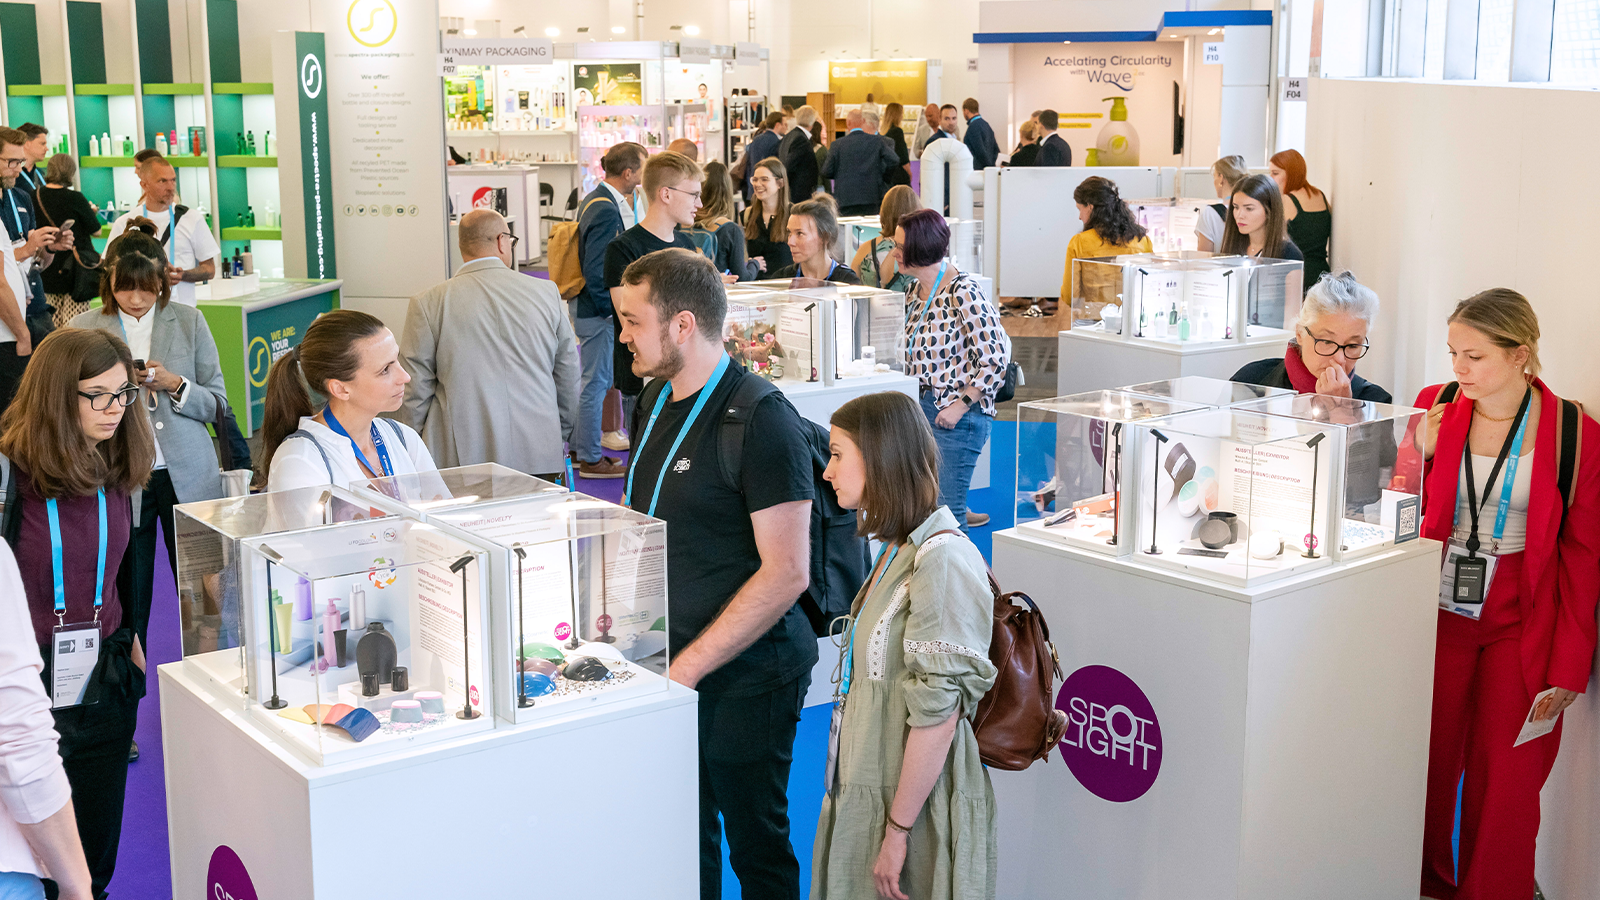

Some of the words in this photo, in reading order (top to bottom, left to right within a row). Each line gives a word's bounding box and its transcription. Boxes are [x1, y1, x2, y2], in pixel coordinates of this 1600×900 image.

[485, 46, 547, 56] PACKAGING
[1044, 55, 1107, 69] Accelating
[1110, 55, 1171, 68] Circularity
[1087, 70, 1132, 84] Wave
[1288, 80, 1299, 88] H4
[1286, 90, 1301, 98] F04
[270, 330, 281, 341] WE
[271, 338, 289, 351] YOUR
[1069, 696, 1154, 745] SPOT
